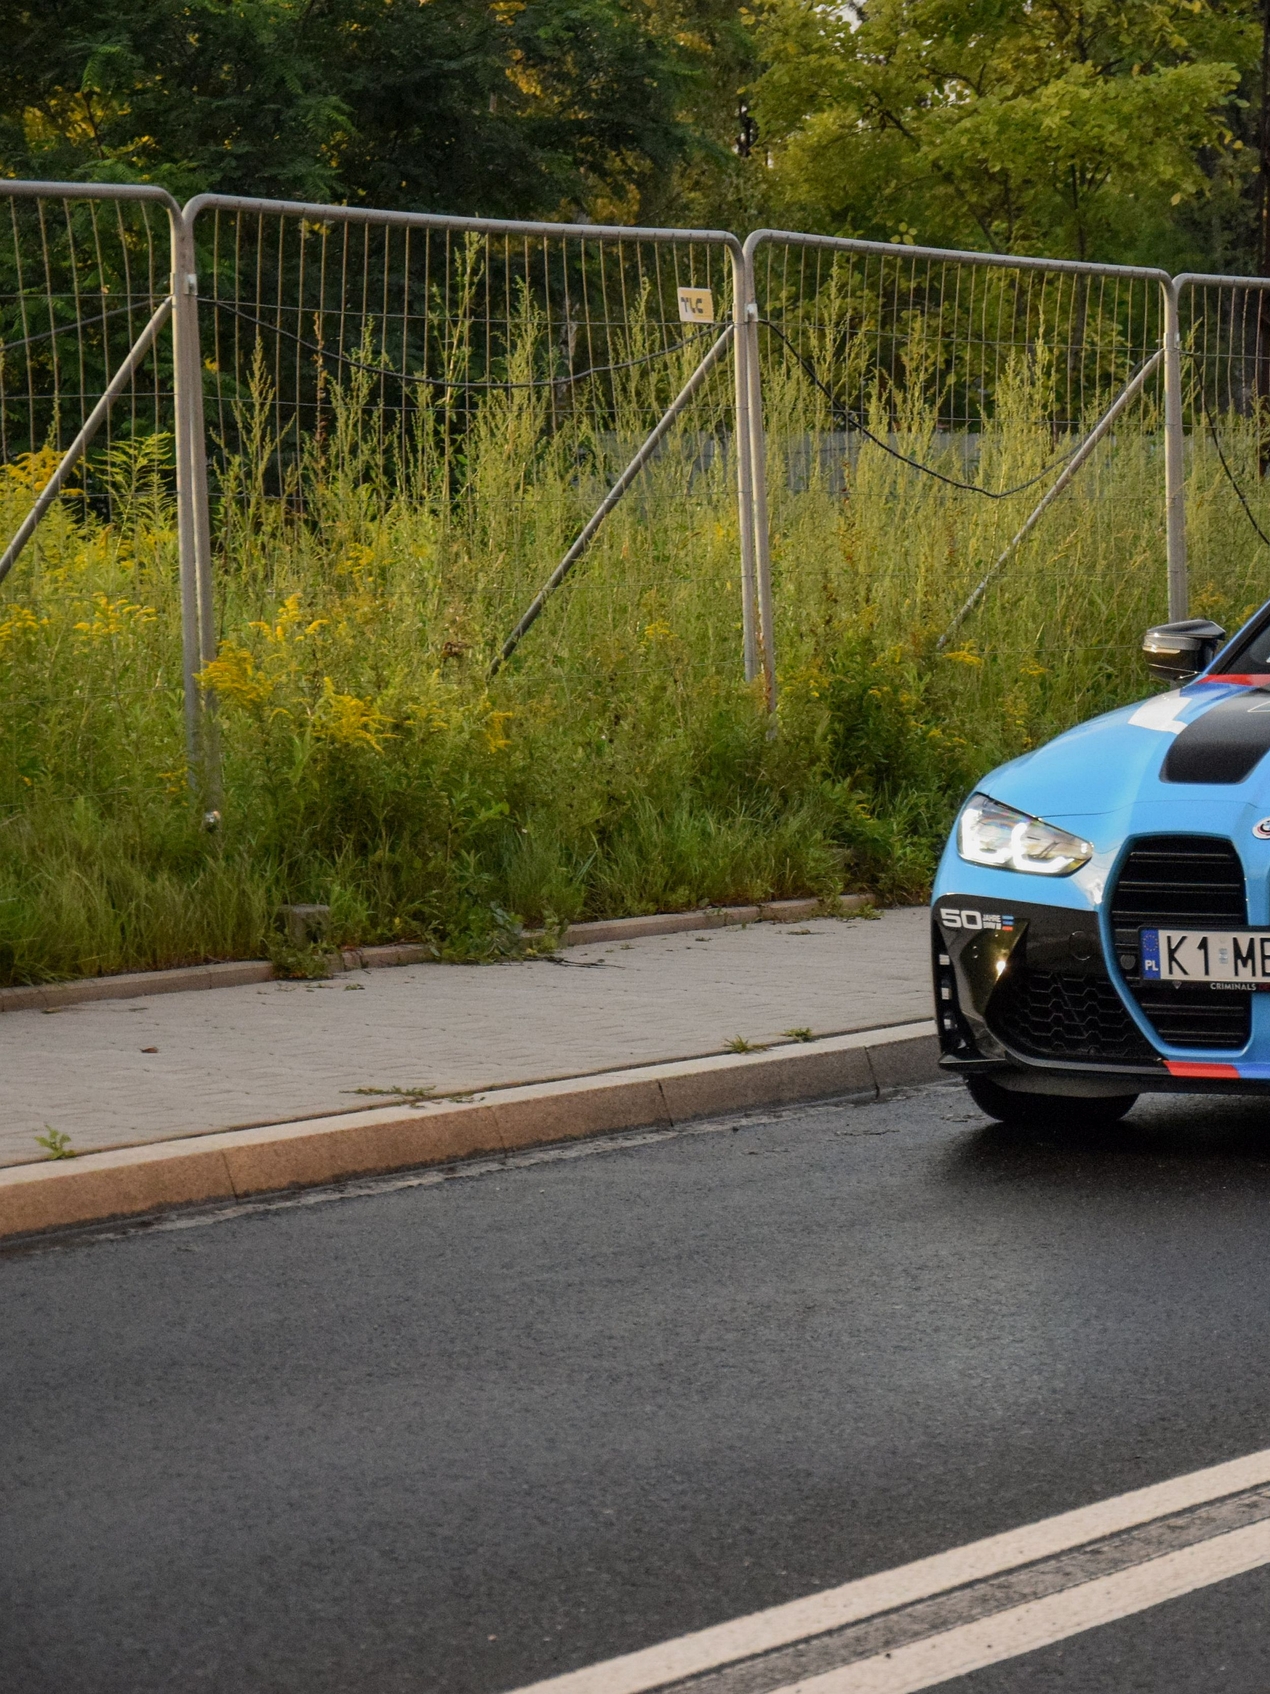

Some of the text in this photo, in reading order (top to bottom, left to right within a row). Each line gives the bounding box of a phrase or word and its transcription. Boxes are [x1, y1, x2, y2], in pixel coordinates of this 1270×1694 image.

[940, 908, 982, 930] 50
[1166, 935, 1210, 976] K1
[1145, 960, 1158, 971] PL
[1210, 982, 1257, 991] CRIMINALS
